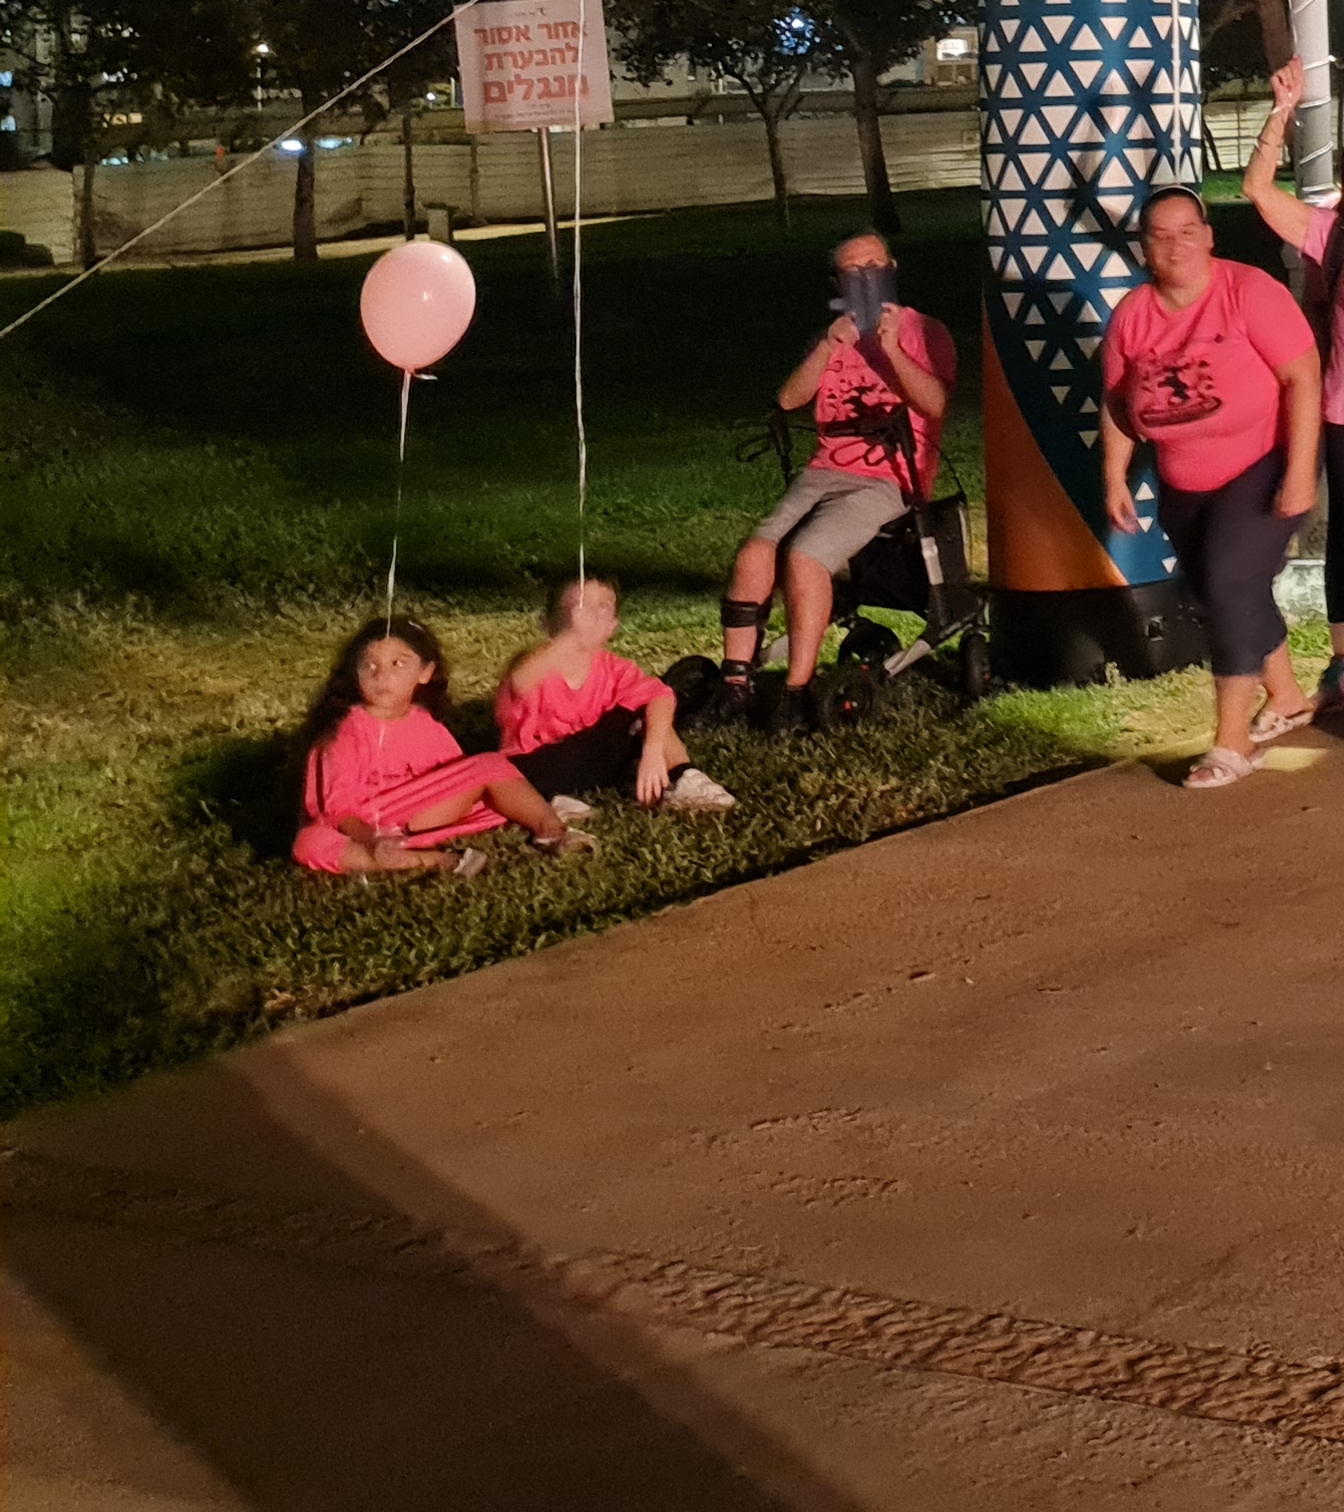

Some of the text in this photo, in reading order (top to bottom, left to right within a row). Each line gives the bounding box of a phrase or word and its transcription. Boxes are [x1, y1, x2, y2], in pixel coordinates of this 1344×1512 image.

[473, 25, 532, 46] אסור
[484, 42, 580, 71] להבערת
[482, 73, 590, 106] מנגלים
